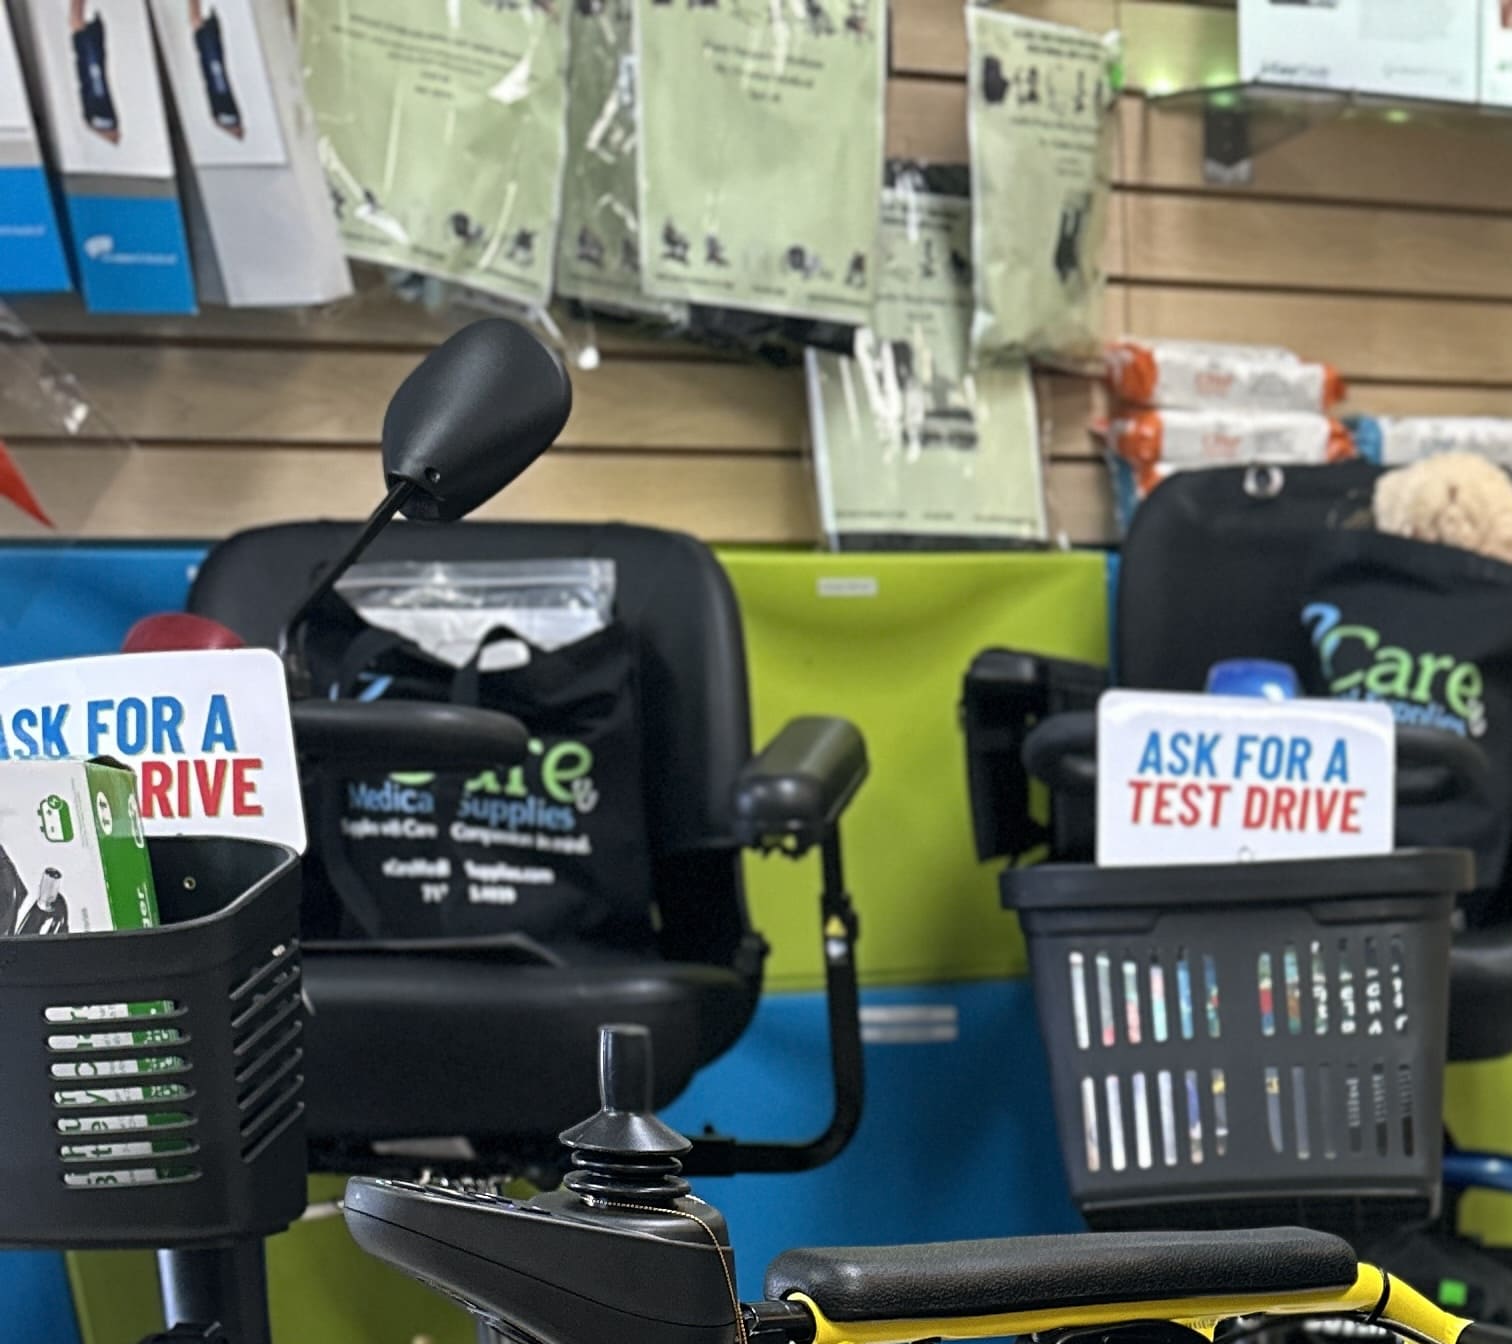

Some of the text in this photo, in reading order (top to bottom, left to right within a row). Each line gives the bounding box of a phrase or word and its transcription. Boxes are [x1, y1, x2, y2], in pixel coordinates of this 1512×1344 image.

[87, 696, 186, 757] FOR
[202, 694, 238, 754] A
[1137, 730, 1350, 784] ASK FOR A
[141, 758, 265, 819] RIVE
[1128, 780, 1366, 834] TEST DRIVE
